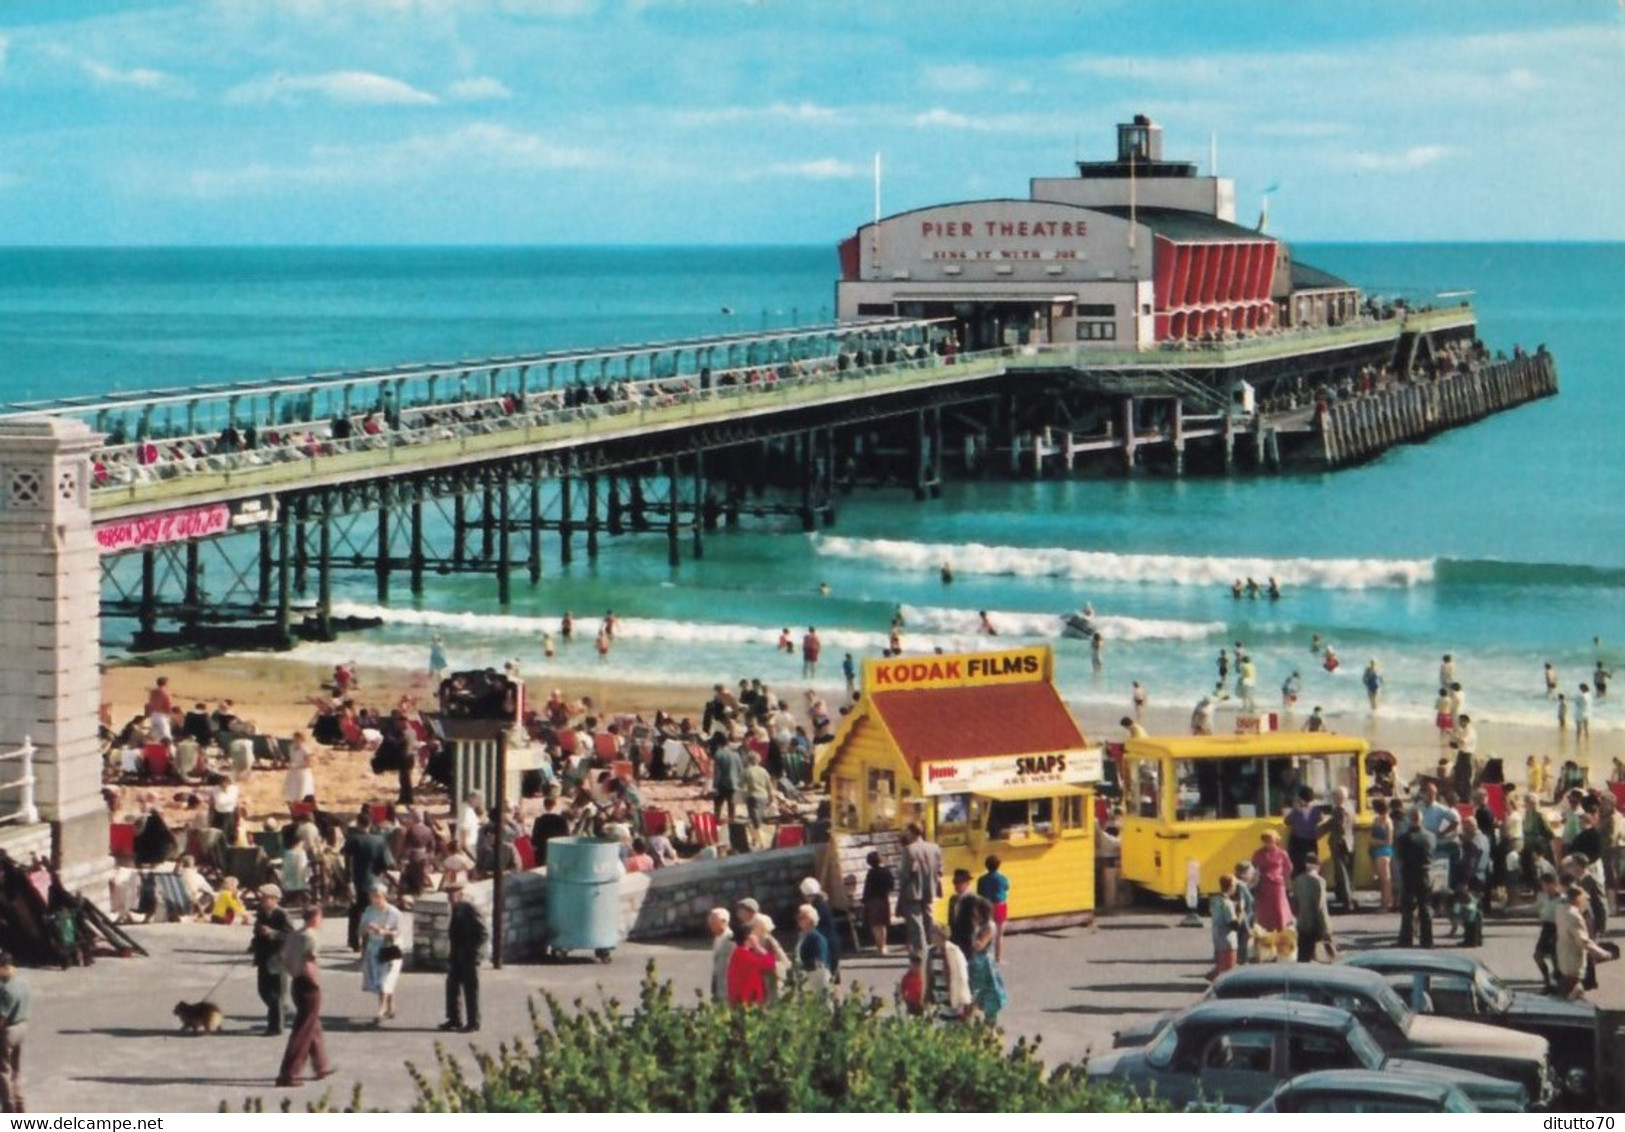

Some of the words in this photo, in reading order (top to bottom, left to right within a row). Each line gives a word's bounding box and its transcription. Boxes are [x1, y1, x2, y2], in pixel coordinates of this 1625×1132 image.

[921, 221, 973, 237] PIER
[985, 221, 1088, 237] THEATRE
[1001, 250, 1041, 260] WITH
[875, 660, 962, 685] KODAK
[967, 655, 1039, 678] FILMS
[1016, 755, 1067, 776] SNAPS
